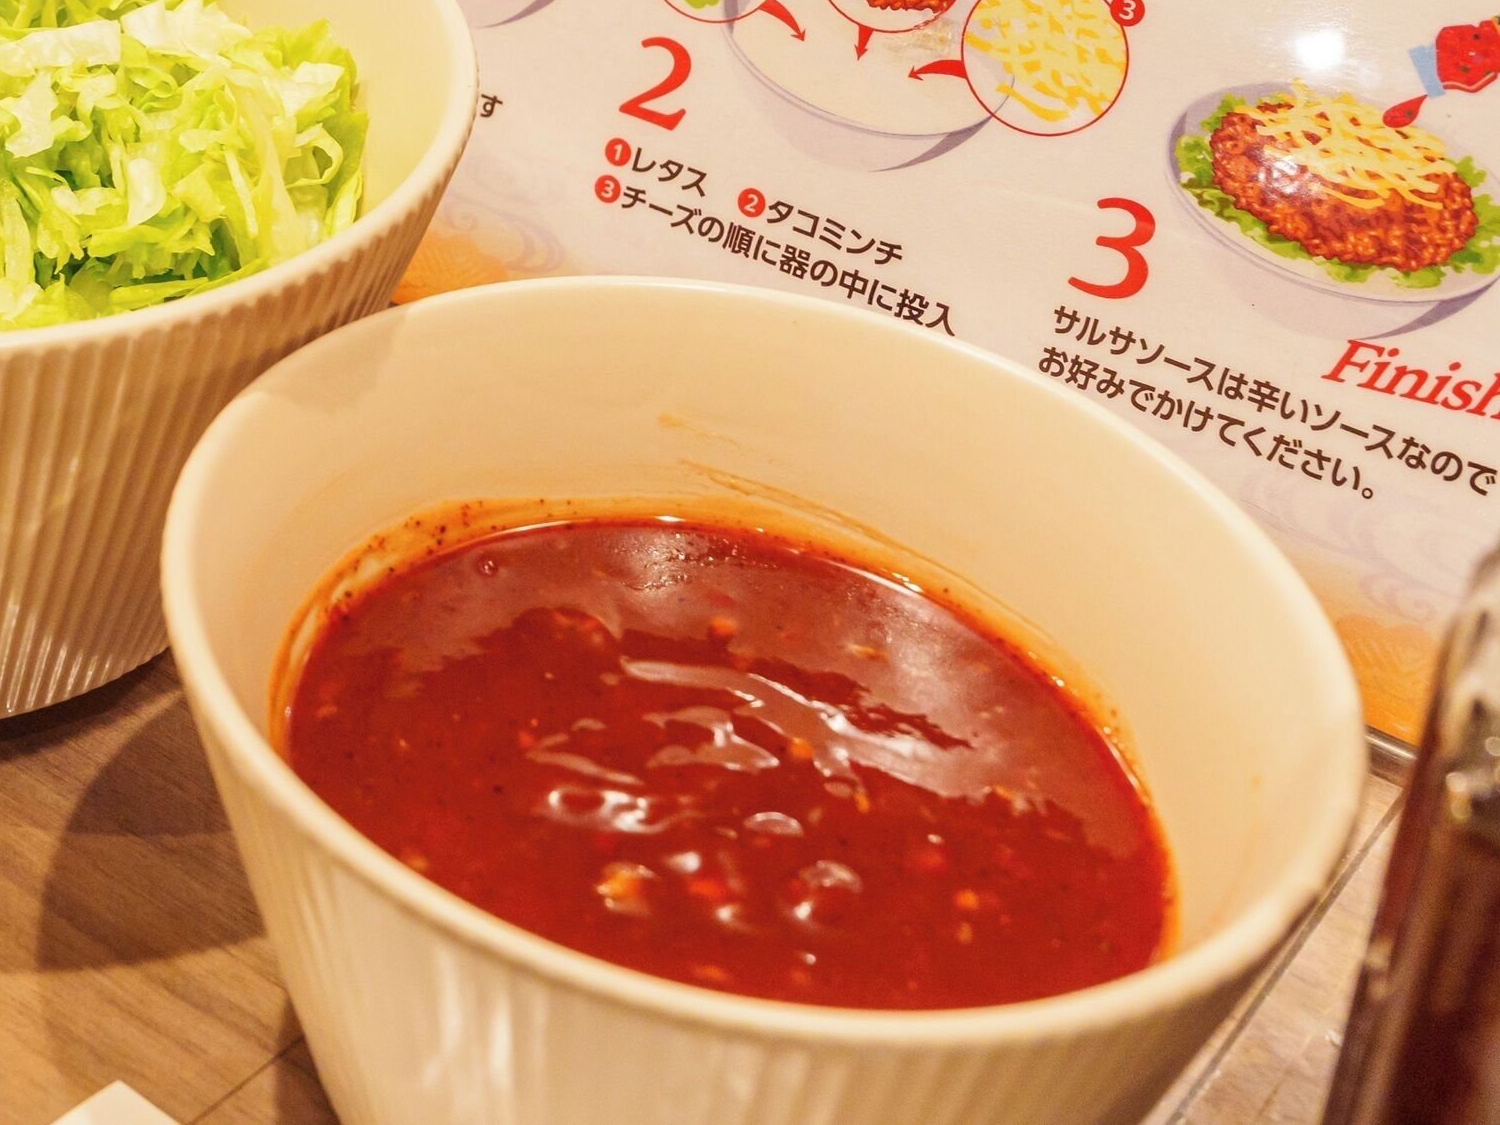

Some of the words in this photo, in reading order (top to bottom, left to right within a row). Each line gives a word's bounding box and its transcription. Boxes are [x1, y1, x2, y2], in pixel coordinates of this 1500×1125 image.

[618, 37, 692, 131] 2
[1067, 197, 1156, 299] 3
[1038, 347, 1374, 500] お好みでかけてください。
[1053, 306, 1497, 496] サルサソースは辛いソースなので
